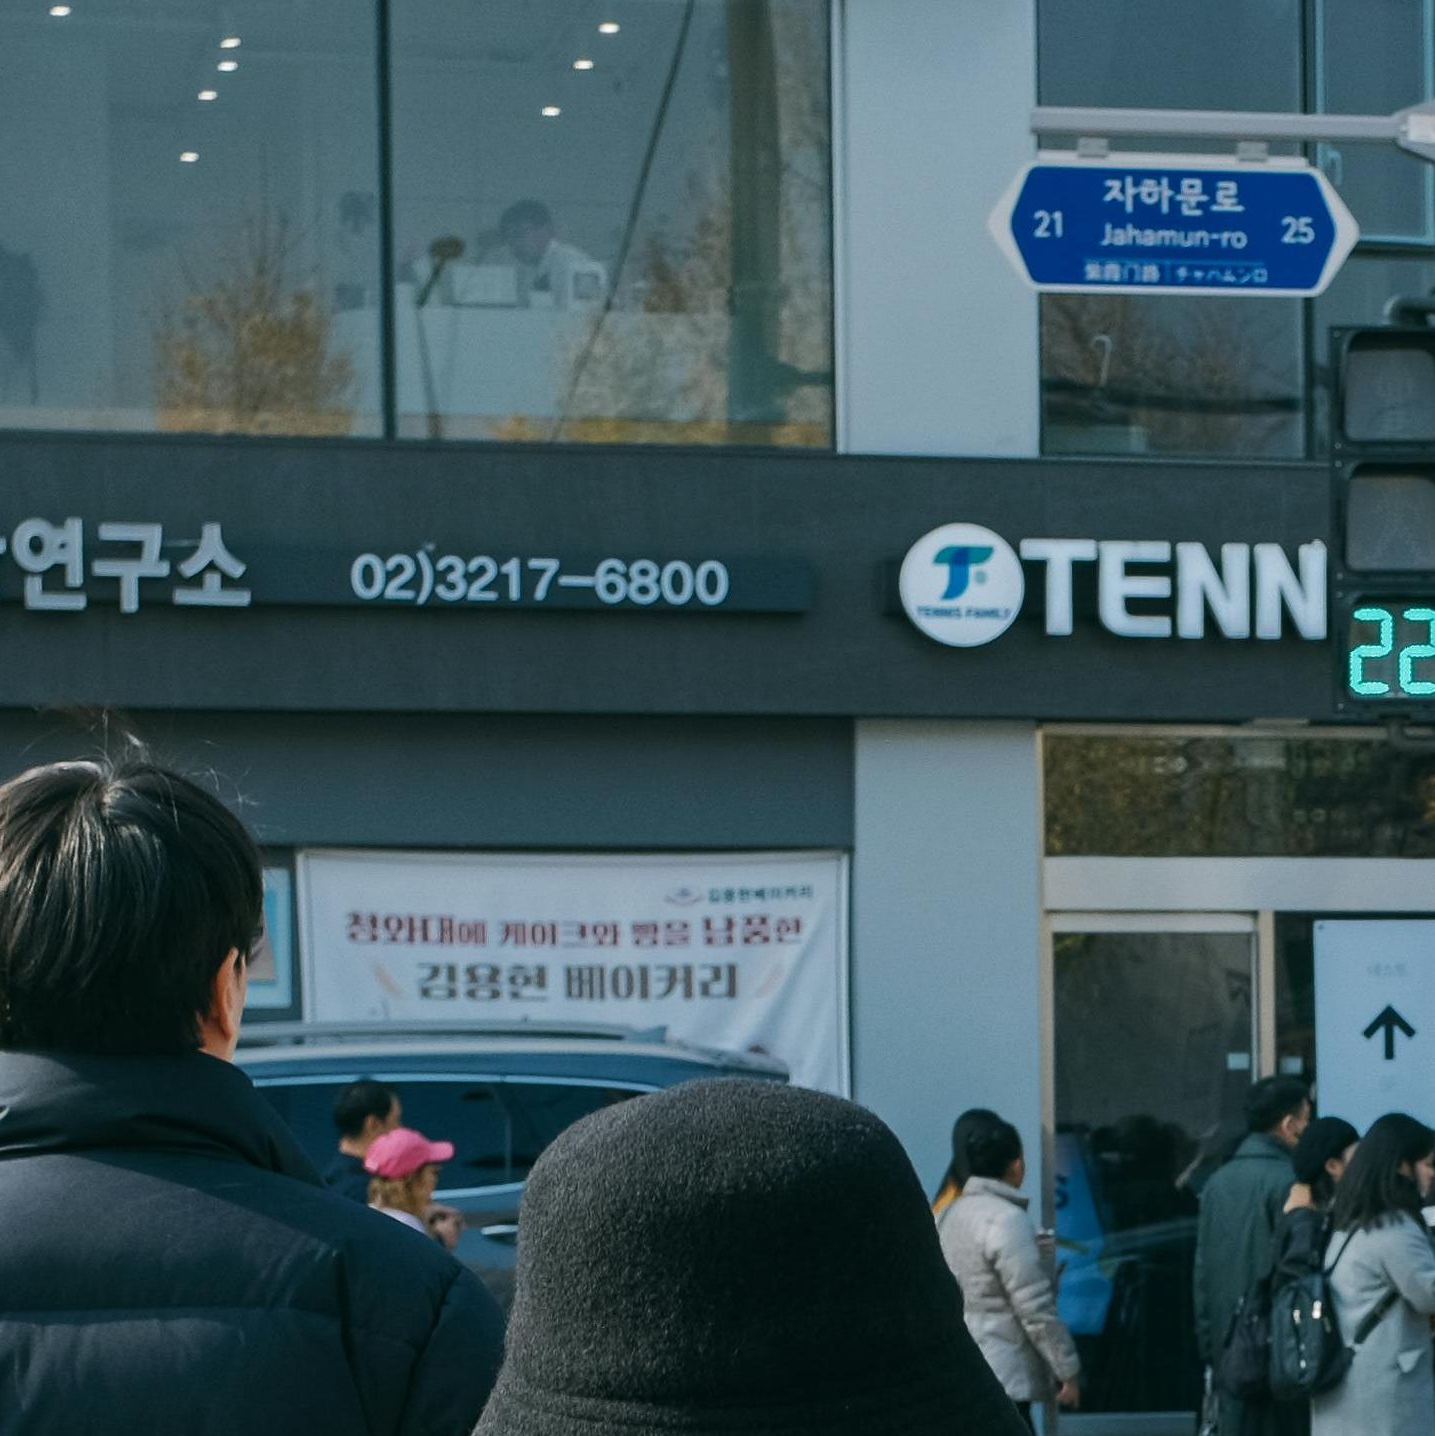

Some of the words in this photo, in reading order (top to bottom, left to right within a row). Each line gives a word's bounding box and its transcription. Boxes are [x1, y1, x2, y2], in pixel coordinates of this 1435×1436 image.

[1103, 175, 1245, 216] 자하문로
[1033, 211, 1063, 238] 21
[1100, 224, 1248, 250] Jahamun-ro
[1281, 217, 1315, 244] 25
[349, 549, 731, 606] 02)3217-6800
[1020, 538, 1327, 640] TENN
[347, 911, 486, 945] 청와대에
[500, 917, 620, 948] 케이크와
[631, 917, 691, 947] 빵을
[702, 913, 804, 946] 납품한
[418, 962, 548, 1001] 김용현
[565, 962, 738, 1001] 베이커리
